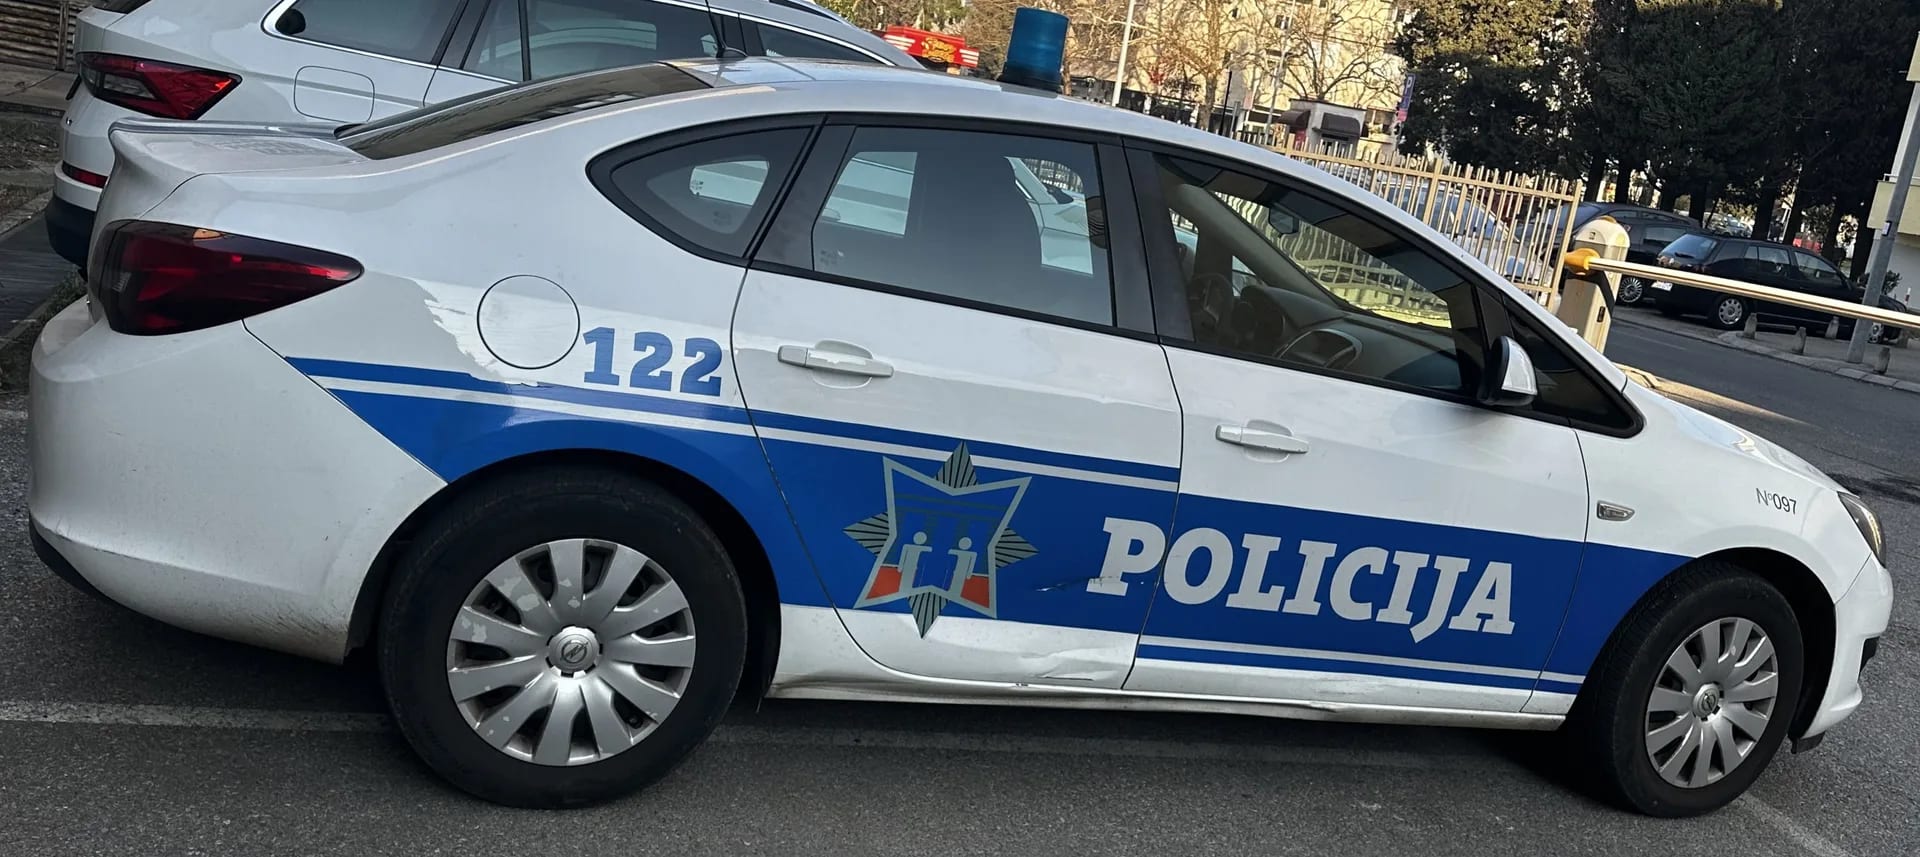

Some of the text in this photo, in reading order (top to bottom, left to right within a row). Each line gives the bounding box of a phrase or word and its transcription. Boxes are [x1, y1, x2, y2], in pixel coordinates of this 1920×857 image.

[1405, 76, 1413, 95] P
[583, 327, 722, 396] 122
[1086, 517, 1516, 643] POLICIJA
